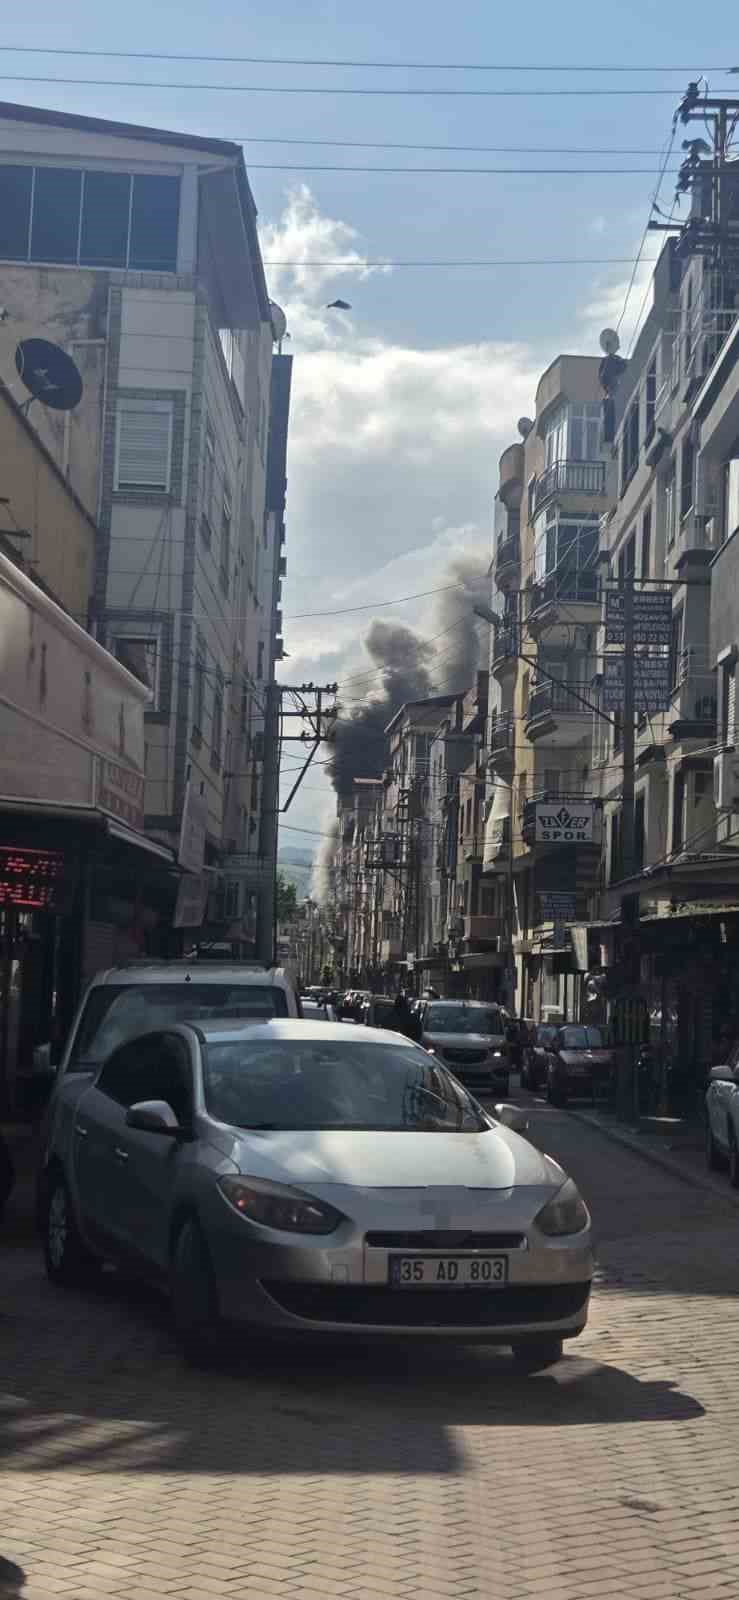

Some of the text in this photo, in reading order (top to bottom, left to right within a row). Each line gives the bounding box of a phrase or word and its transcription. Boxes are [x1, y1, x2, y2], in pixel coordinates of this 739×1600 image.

[542, 831, 587, 841] SPOR
[402, 1261, 424, 1281] 35
[436, 1261, 459, 1281] AD
[470, 1261, 503, 1281] 803
